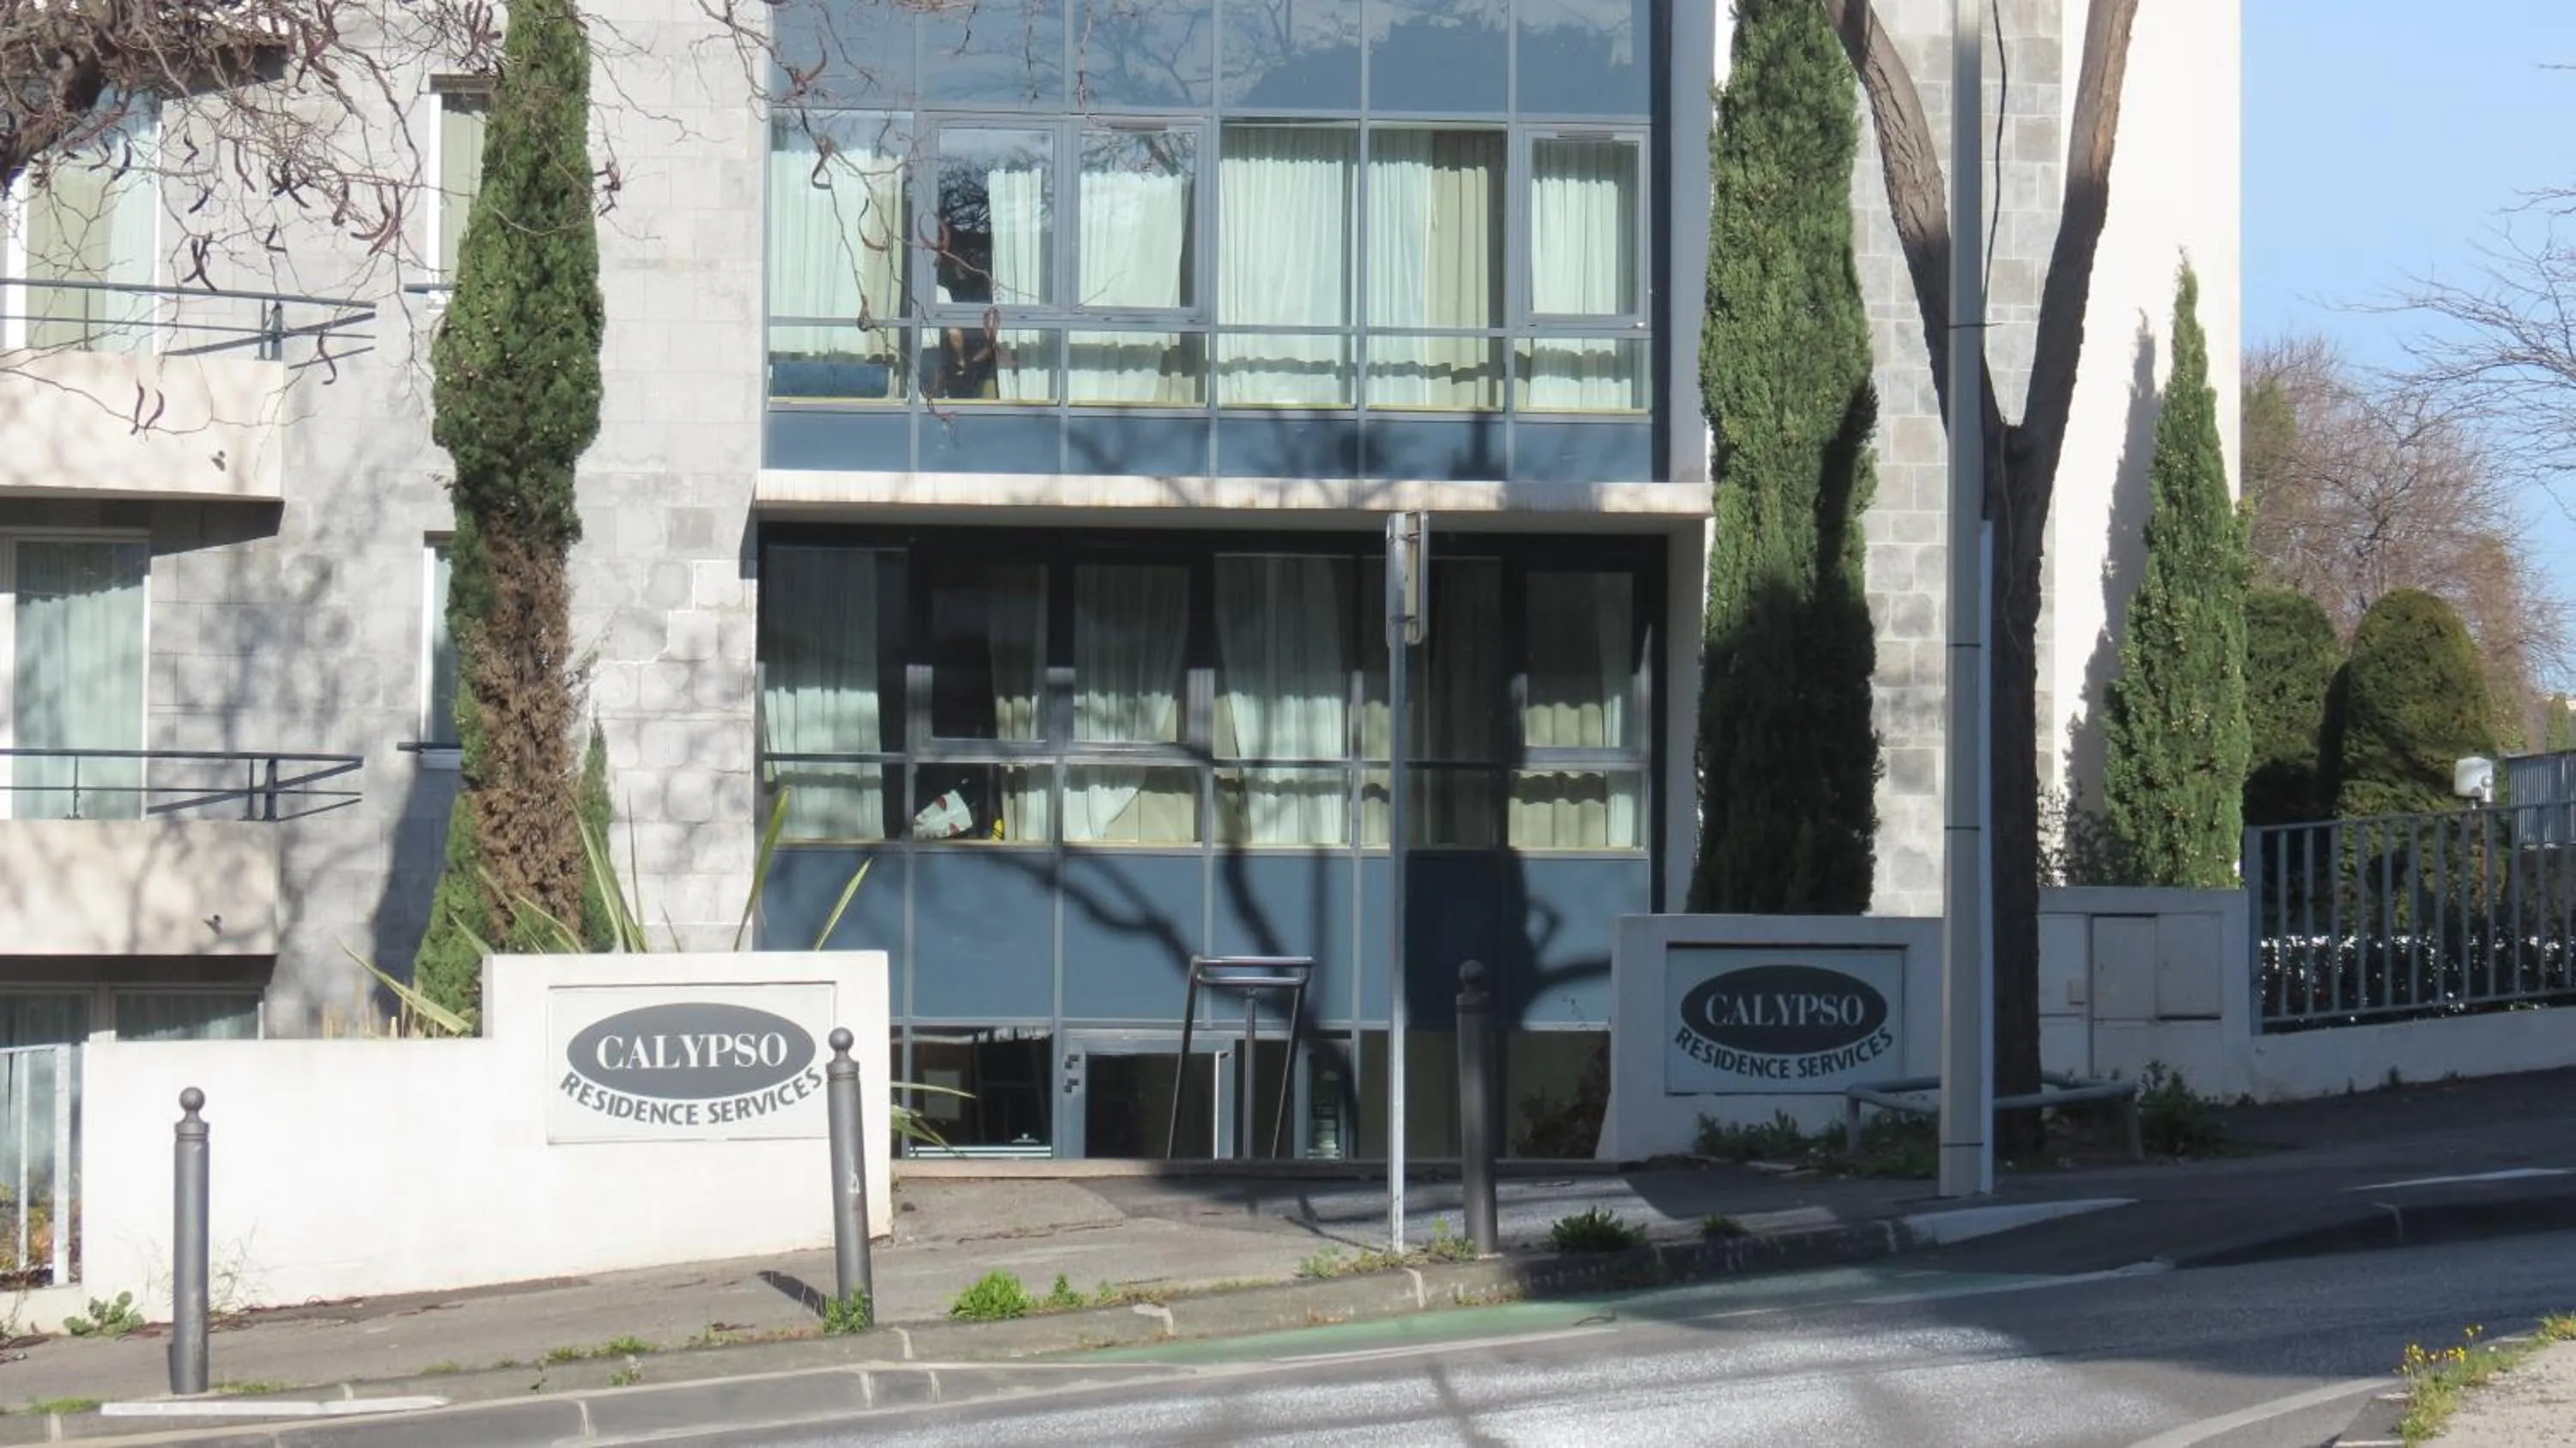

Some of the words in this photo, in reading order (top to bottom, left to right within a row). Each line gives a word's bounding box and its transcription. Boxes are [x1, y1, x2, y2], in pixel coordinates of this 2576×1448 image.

[1705, 993, 1864, 1026] CALYPSO
[596, 1031, 787, 1070] CALYPSO
[1674, 1026, 1790, 1079] RESIDENCE
[1797, 1027, 1893, 1077] SERVICES
[559, 1071, 698, 1125] RESIDENCE
[708, 1068, 822, 1123] SERVICES
